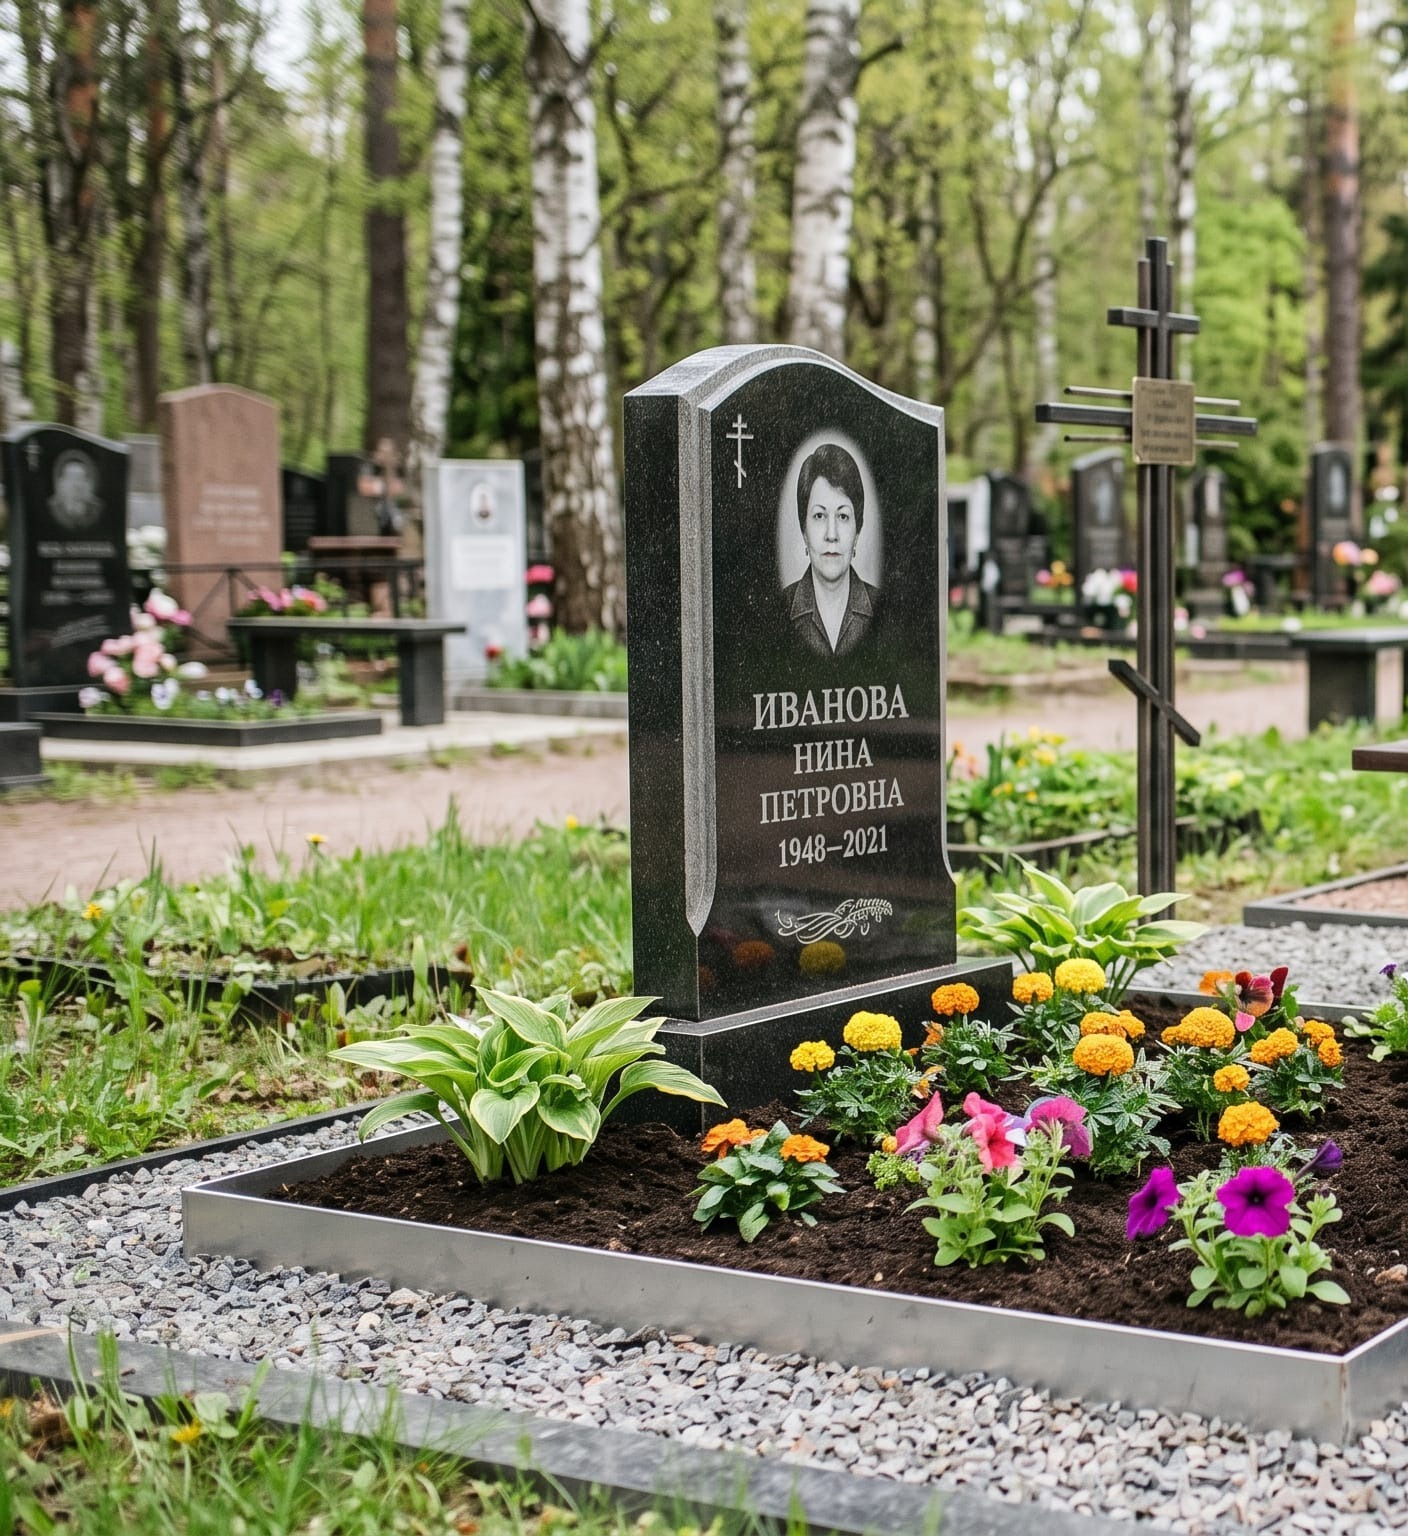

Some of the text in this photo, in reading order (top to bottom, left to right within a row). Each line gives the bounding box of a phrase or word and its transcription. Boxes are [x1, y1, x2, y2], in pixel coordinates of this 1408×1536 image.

[752, 683, 910, 731] ИВАНОВА
[793, 737, 874, 775] НИНА
[759, 777, 905, 825] ПЕТРОВНА
